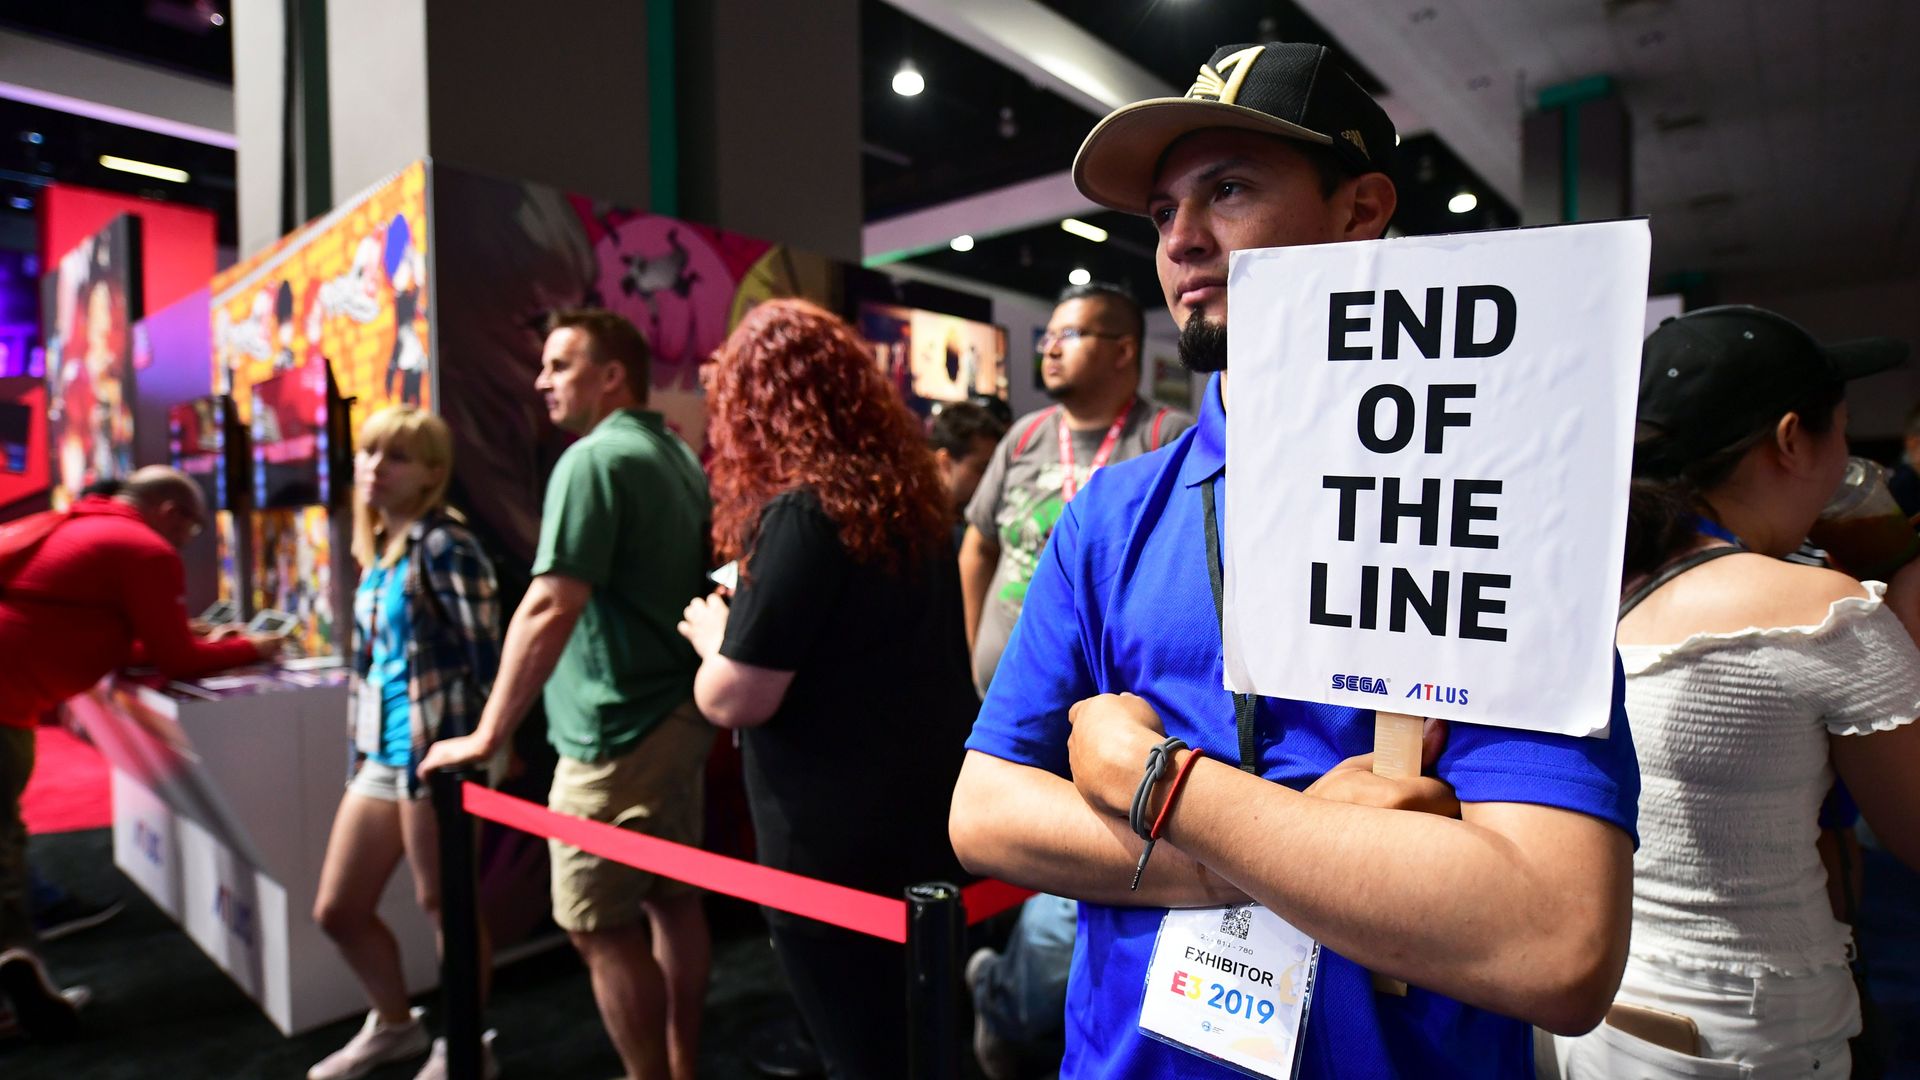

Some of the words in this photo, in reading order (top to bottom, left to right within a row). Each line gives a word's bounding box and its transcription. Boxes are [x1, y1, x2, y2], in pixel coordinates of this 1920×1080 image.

[1327, 284, 1517, 362] END
[1357, 383, 1477, 454] OF
[1322, 475, 1503, 550] THE
[1309, 561, 1512, 643] LINE
[1332, 674, 1388, 695] SEGA
[1405, 683, 1469, 706] ATLUS
[1170, 970, 1204, 1000] E3
[1207, 983, 1275, 1025] 2019
[1185, 946, 1274, 987] EXHIBITOR
